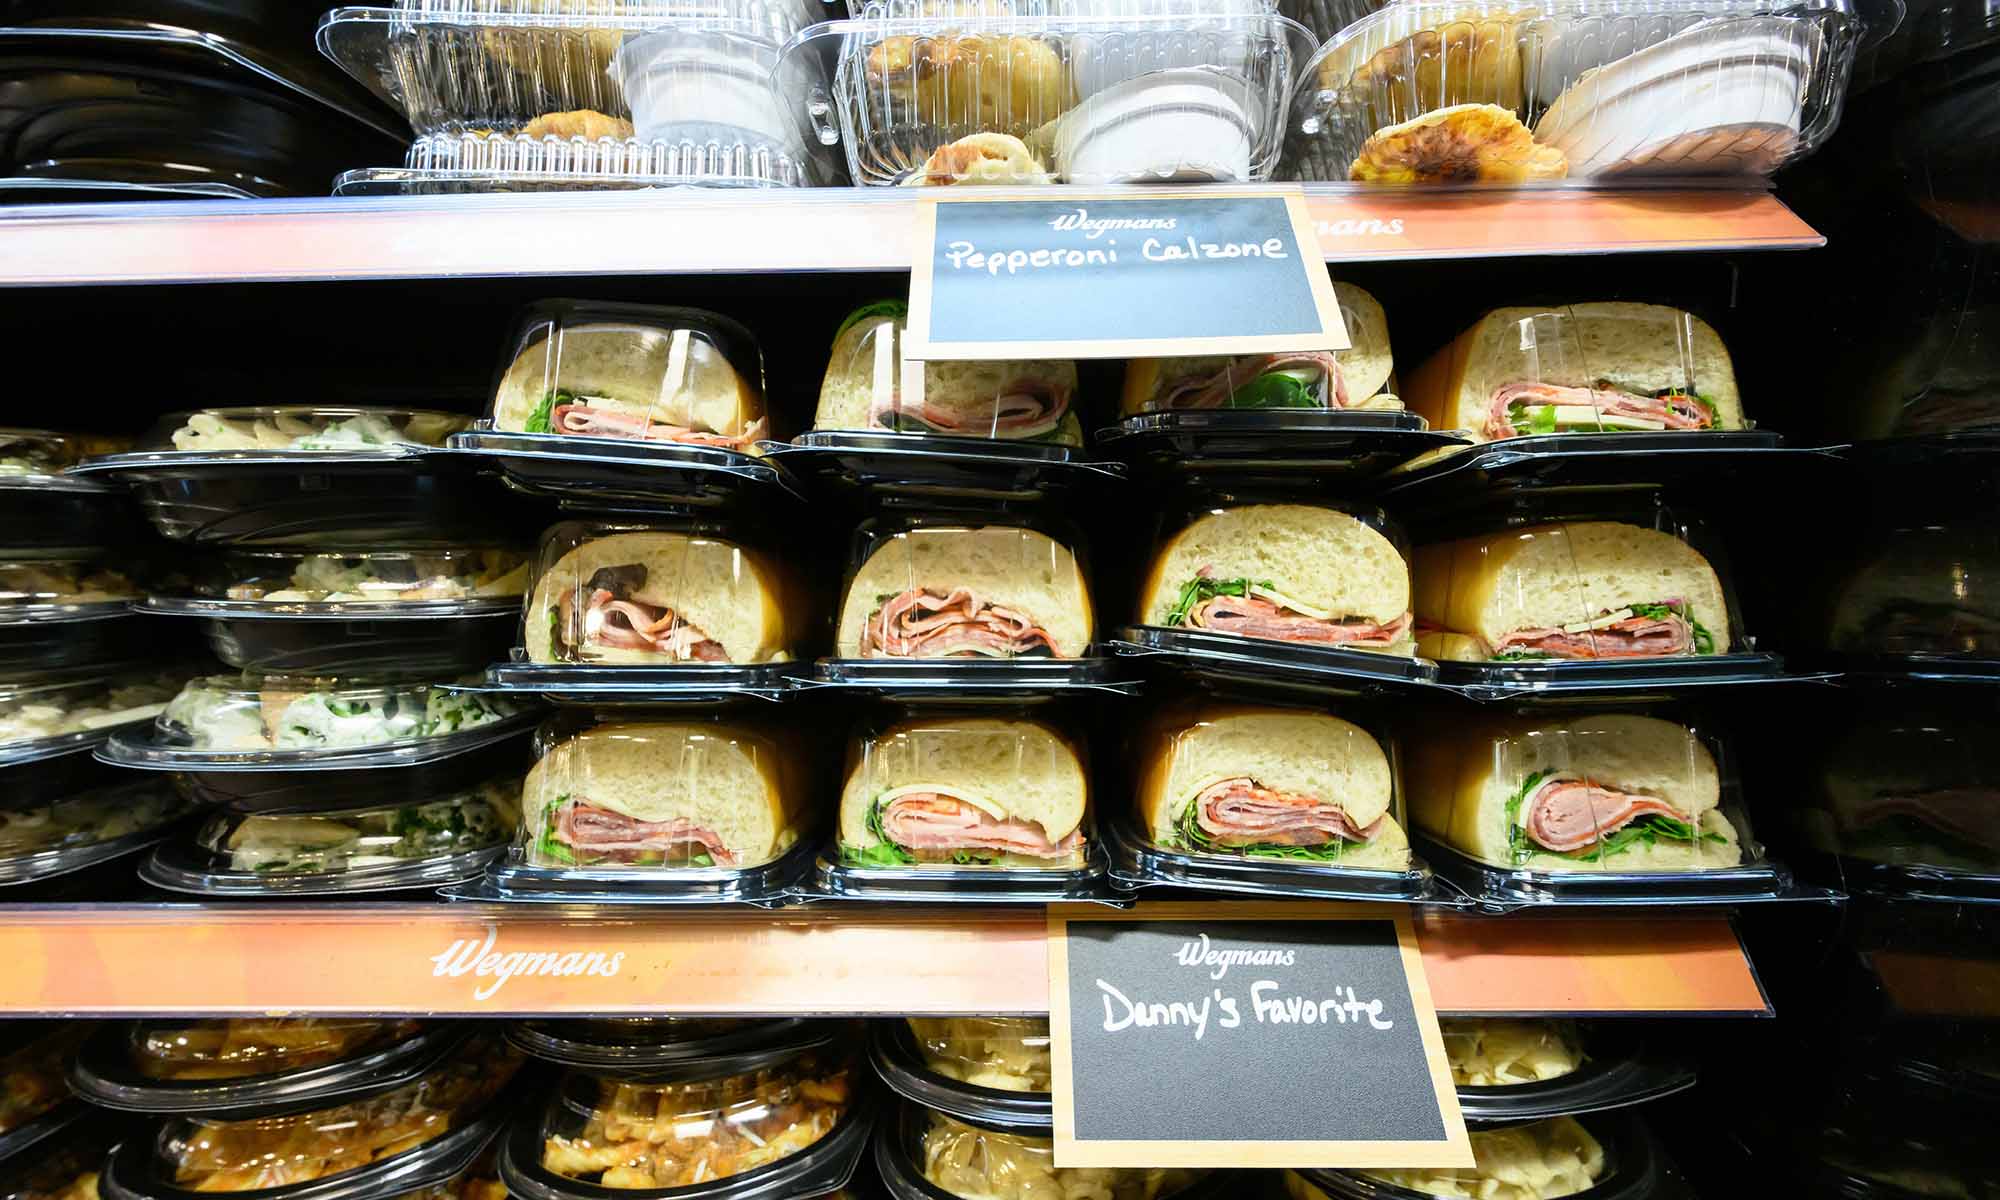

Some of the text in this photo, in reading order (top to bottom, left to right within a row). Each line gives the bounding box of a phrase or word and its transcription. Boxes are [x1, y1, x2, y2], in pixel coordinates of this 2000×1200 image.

[1048, 208, 1177, 238] Wegmans
[946, 237, 1289, 274] Pepperoni Calzone
[431, 926, 624, 1000] Wegmans
[1173, 933, 1295, 980] Wegmans
[1096, 979, 1393, 1040] Danny's Favorite
